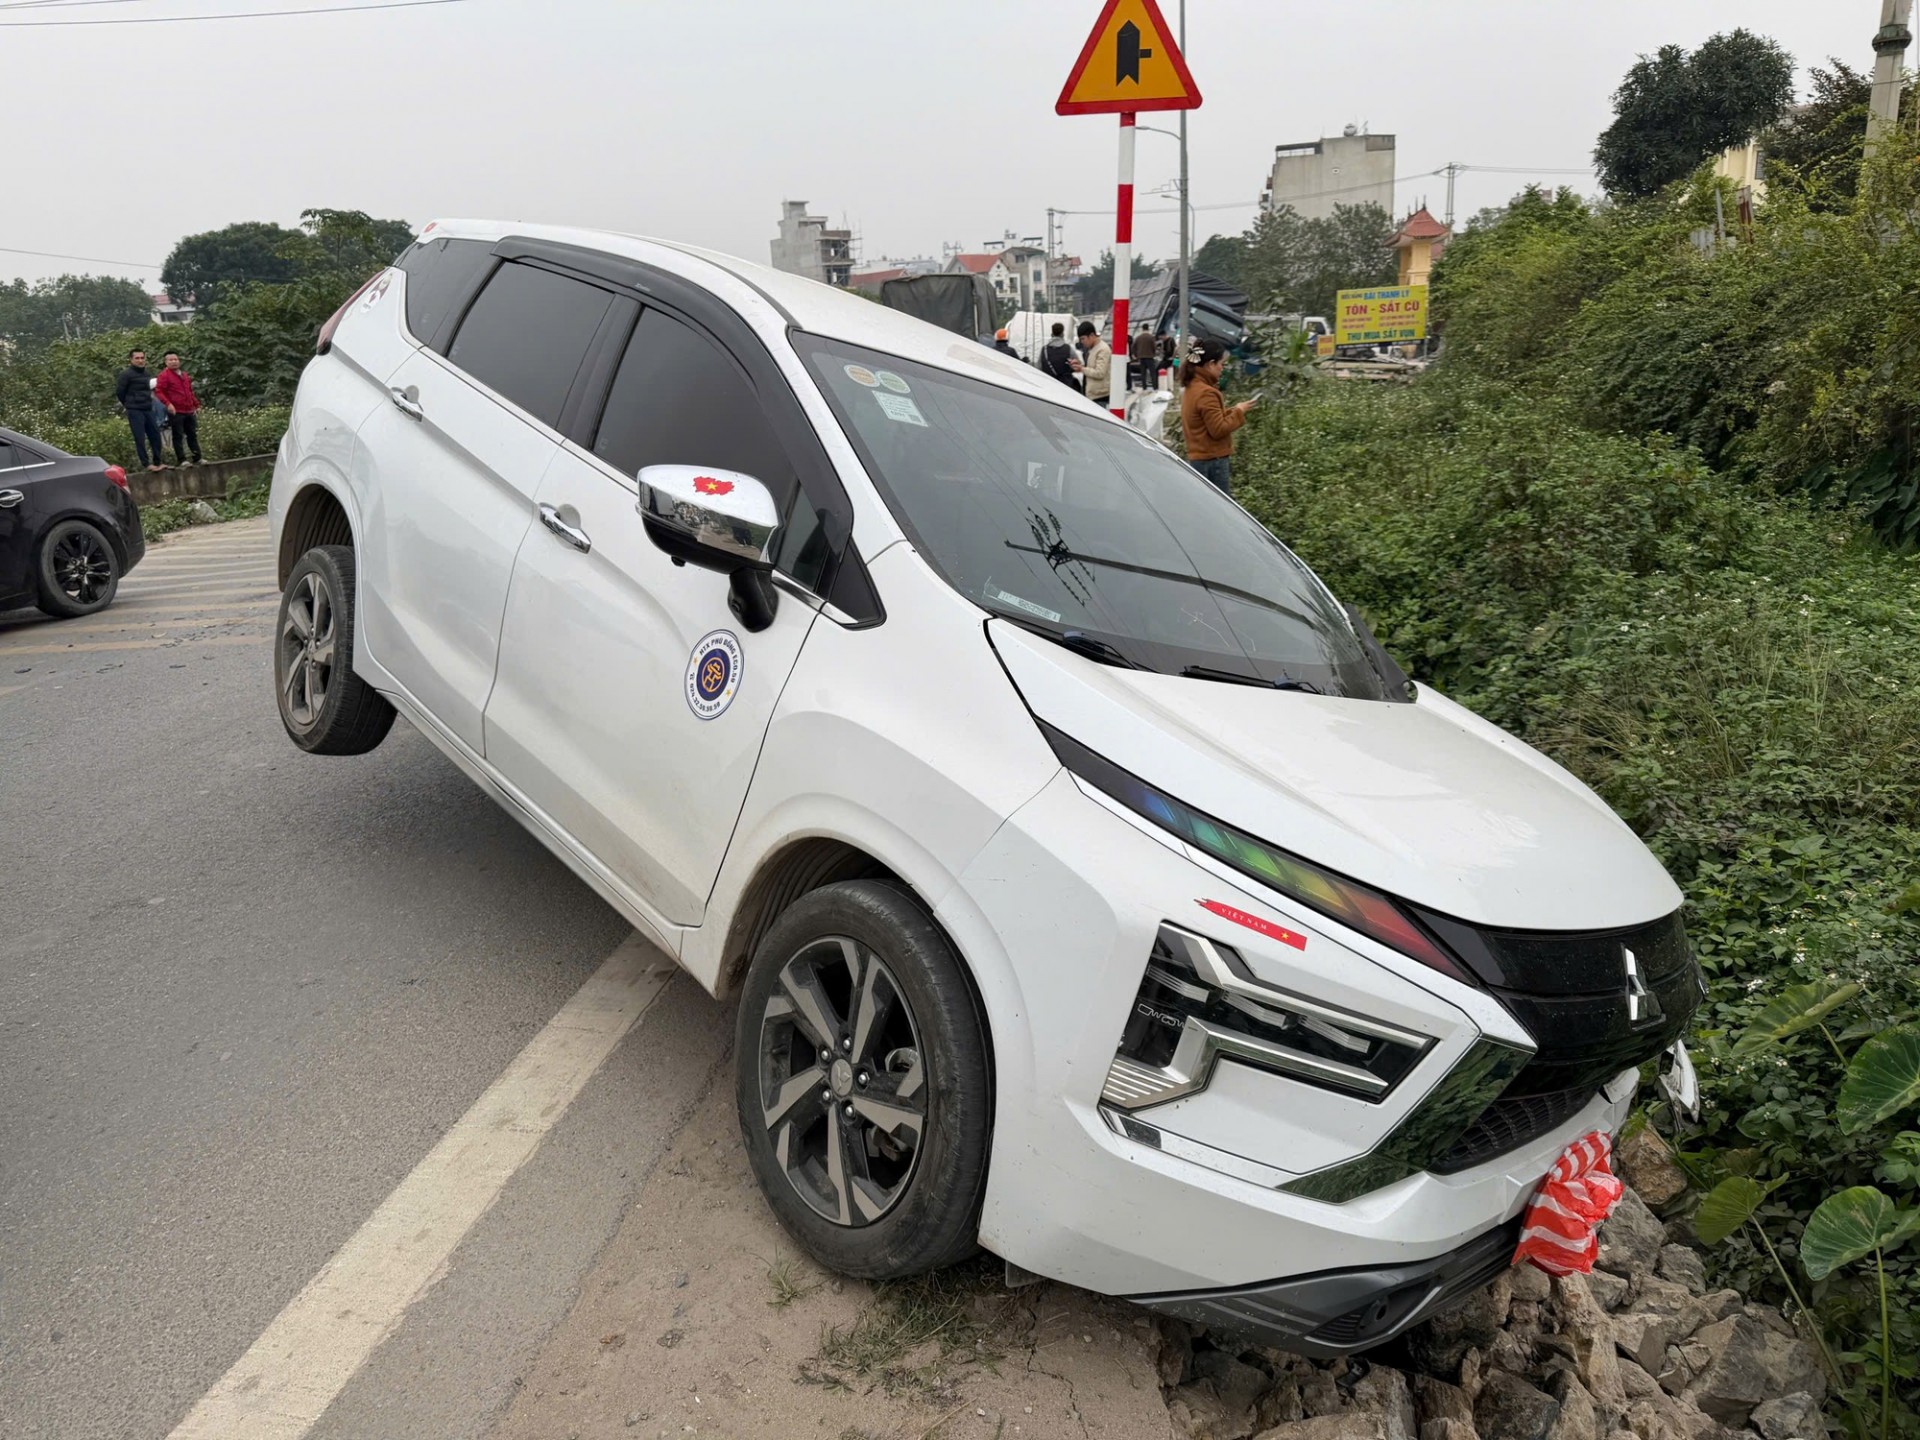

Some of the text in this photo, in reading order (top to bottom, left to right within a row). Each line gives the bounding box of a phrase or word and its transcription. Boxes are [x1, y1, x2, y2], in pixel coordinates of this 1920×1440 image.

[1345, 303, 1367, 315] TÔN
[1379, 300, 1401, 313] SẮT
[699, 642, 710, 656] HTX
[1246, 918, 1267, 930] NAM
